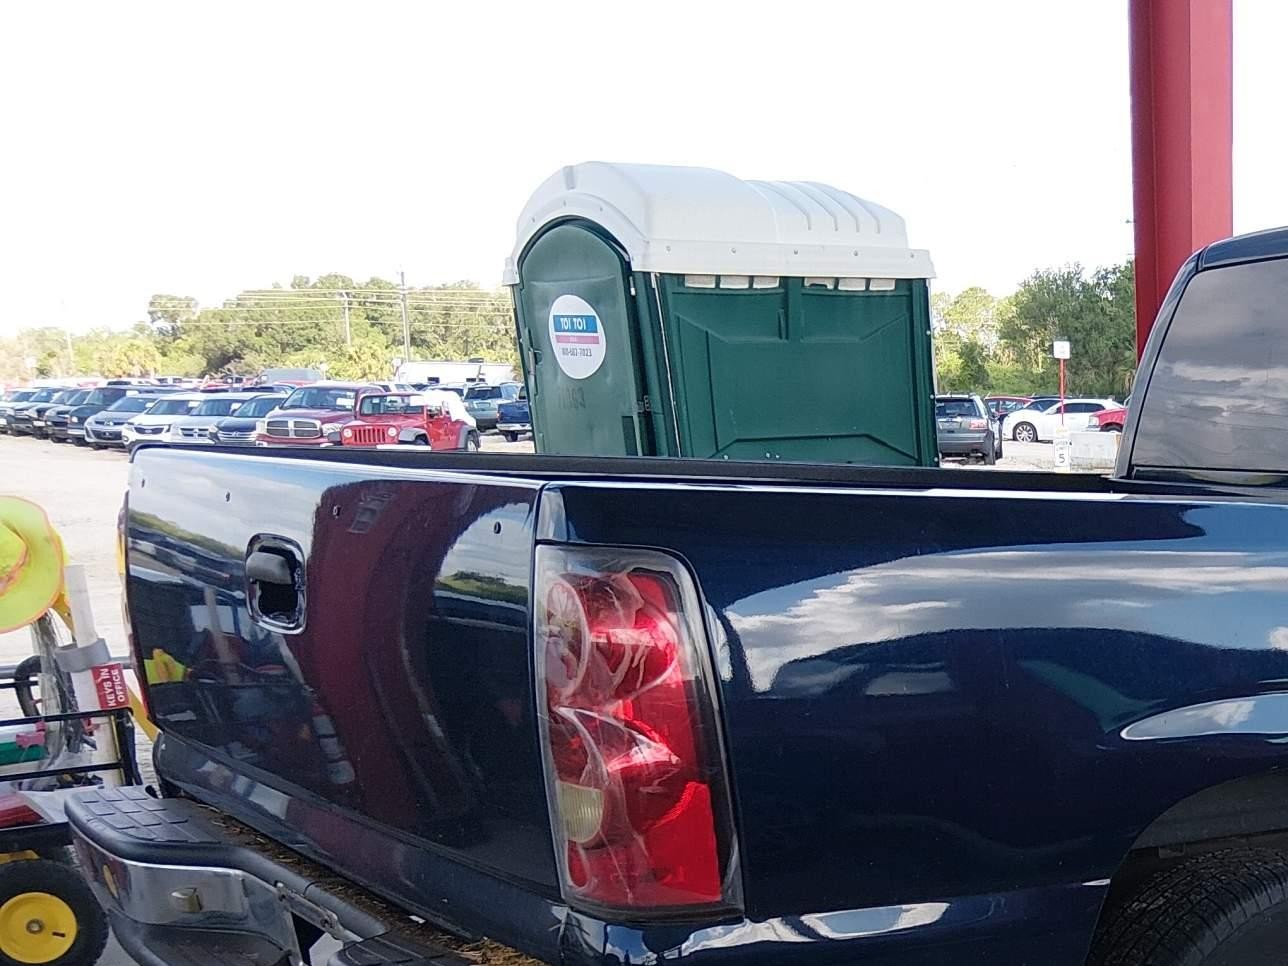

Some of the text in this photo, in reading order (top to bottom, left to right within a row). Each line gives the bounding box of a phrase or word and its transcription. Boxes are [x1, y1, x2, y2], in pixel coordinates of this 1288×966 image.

[1059, 453, 1066, 464] 5
[100, 669, 117, 706] KEYS IN
[111, 669, 125, 702] OFFICE
